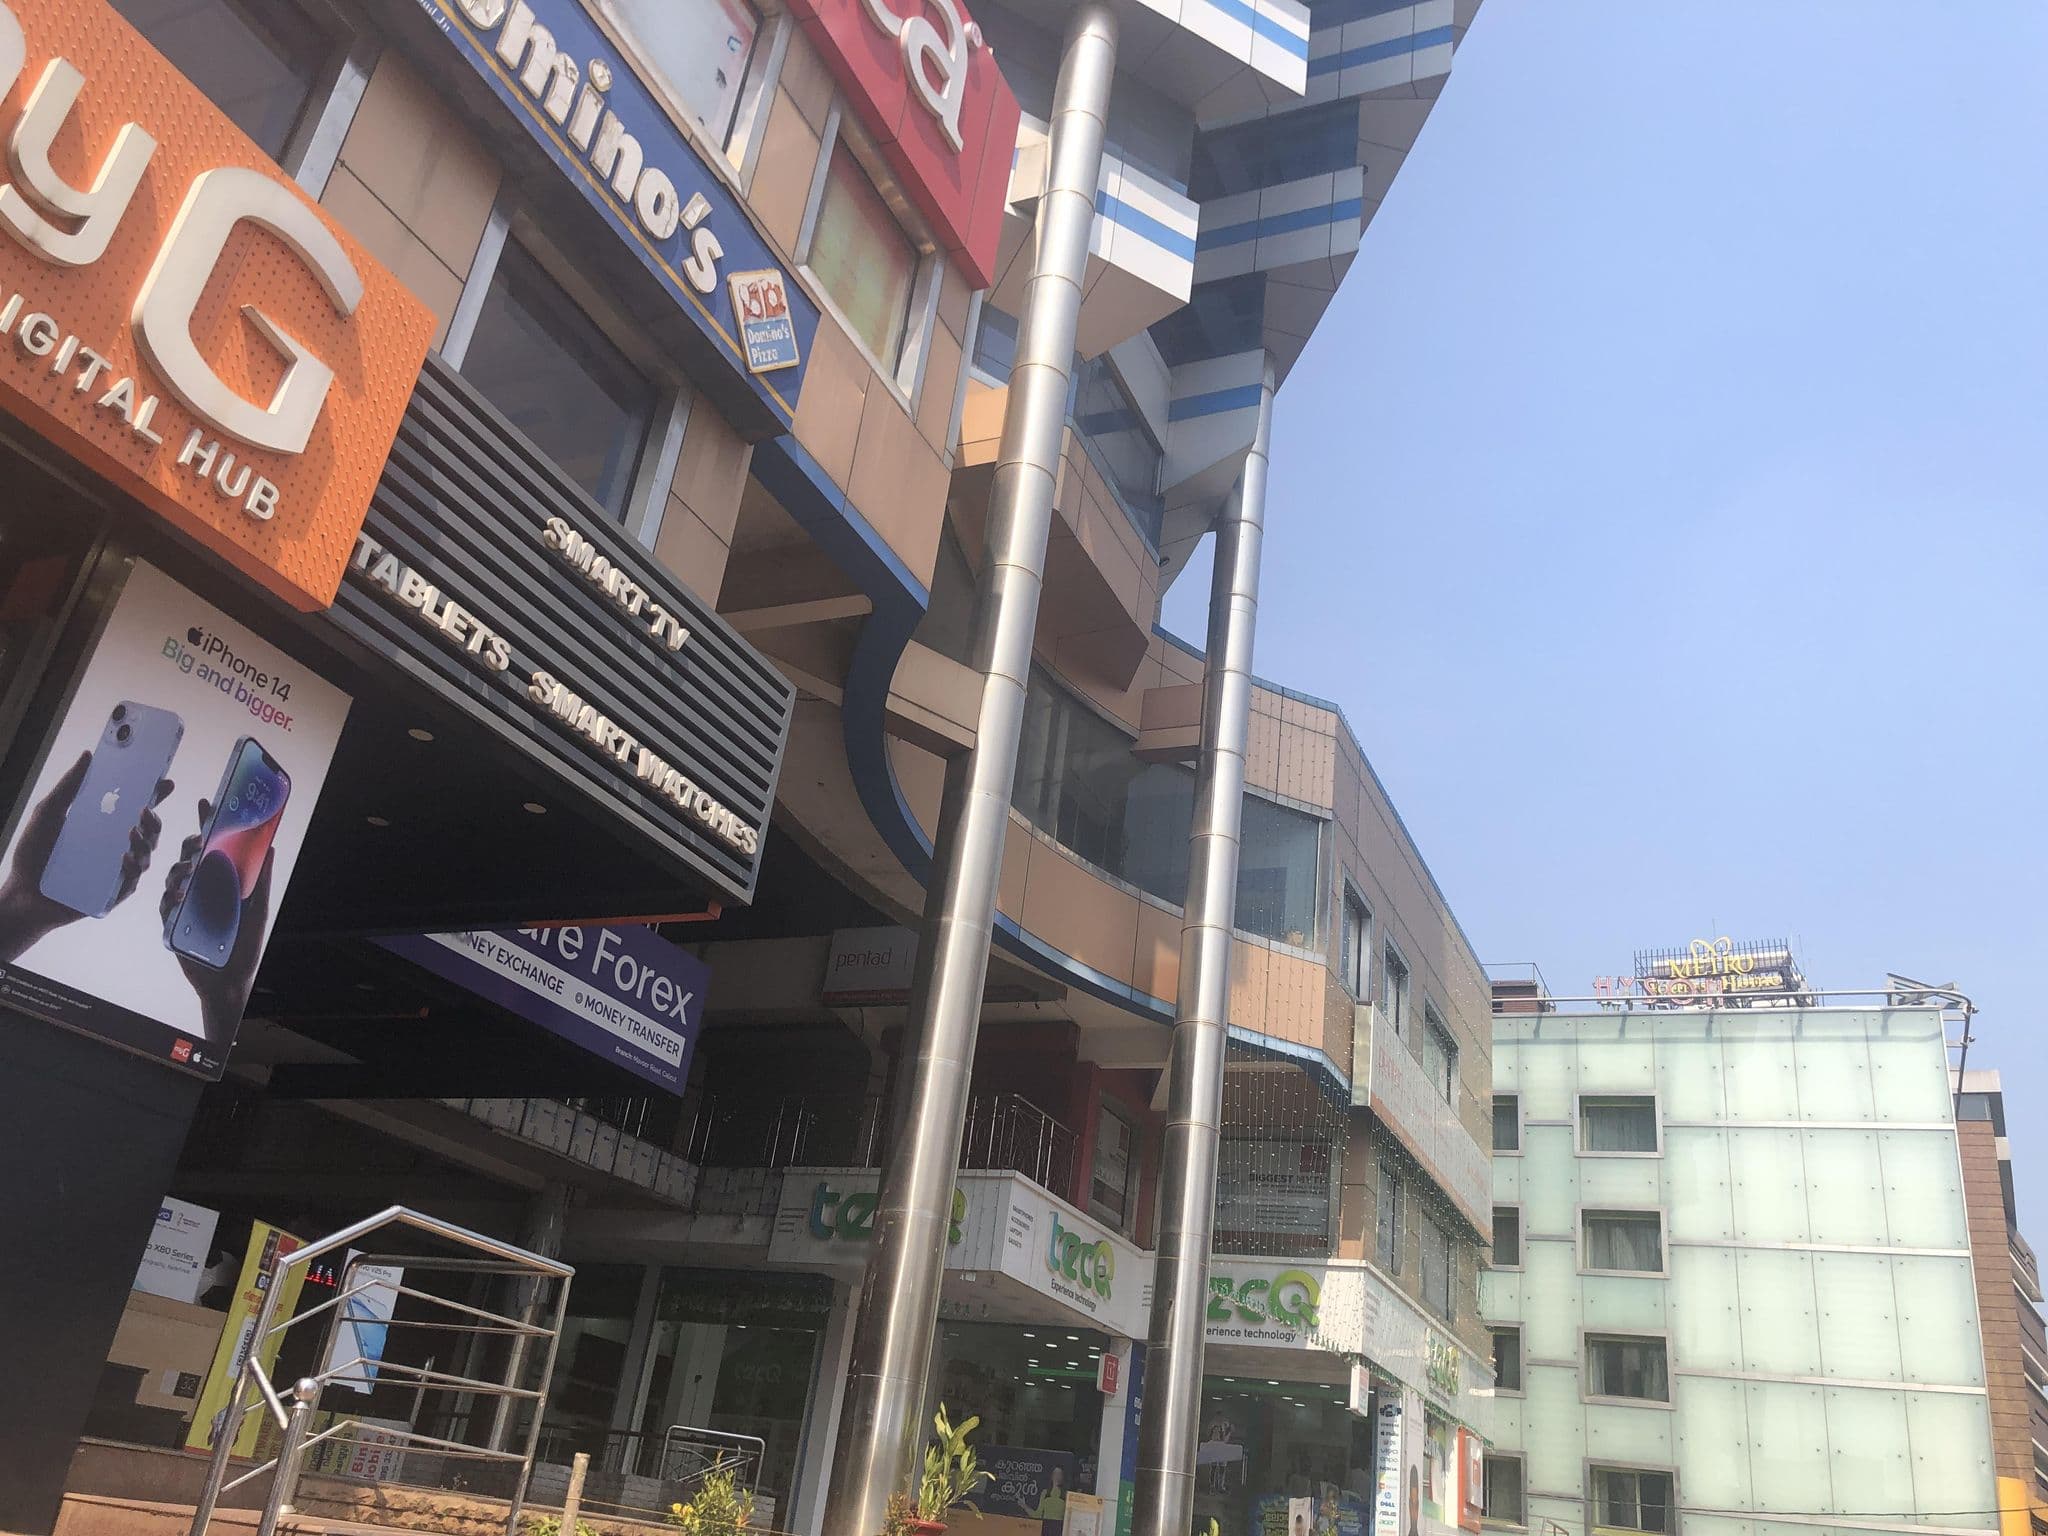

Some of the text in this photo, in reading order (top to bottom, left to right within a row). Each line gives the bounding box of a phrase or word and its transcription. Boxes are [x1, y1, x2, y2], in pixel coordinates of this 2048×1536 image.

[0, 0, 364, 455] yG
[746, 324, 790, 345] Domino's
[751, 347, 779, 364] Pizza
[0, 285, 280, 521] IGITAL HUB
[543, 516, 690, 652] SMART TV
[162, 637, 293, 732] Big and bigger.
[202, 633, 291, 702] iPhone 14
[353, 536, 758, 855] TABLETS SMART WATCHES
[496, 949, 565, 995] EXCHANGE
[591, 928, 694, 1025] Forex
[835, 947, 892, 972] pentad
[585, 995, 680, 1057] MONEY TRANSFER
[172, 1249, 194, 1261] Series
[1244, 1328, 1297, 1342] technology
